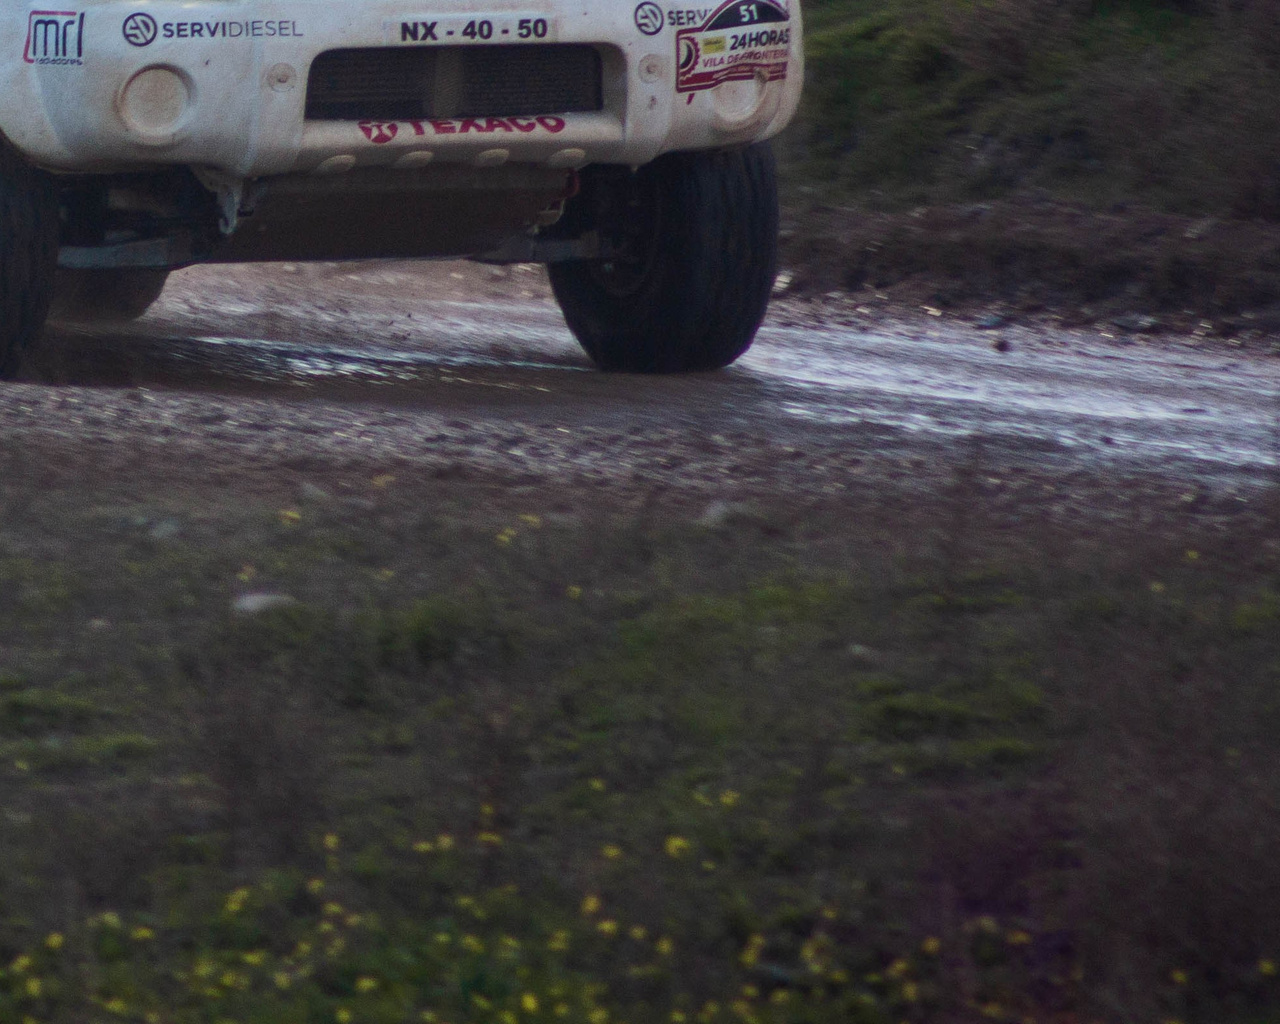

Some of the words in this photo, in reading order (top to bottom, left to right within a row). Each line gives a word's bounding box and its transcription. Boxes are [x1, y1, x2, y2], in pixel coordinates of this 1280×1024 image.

[667, 8, 712, 26] SERV
[739, 4, 759, 22] 51
[162, 20, 304, 38] SERVIDIESEL
[401, 22, 438, 41] NX
[462, 20, 493, 39] 40
[518, 18, 547, 38] 50
[703, 57, 725, 68] VILA
[408, 116, 566, 136] TEXACO
